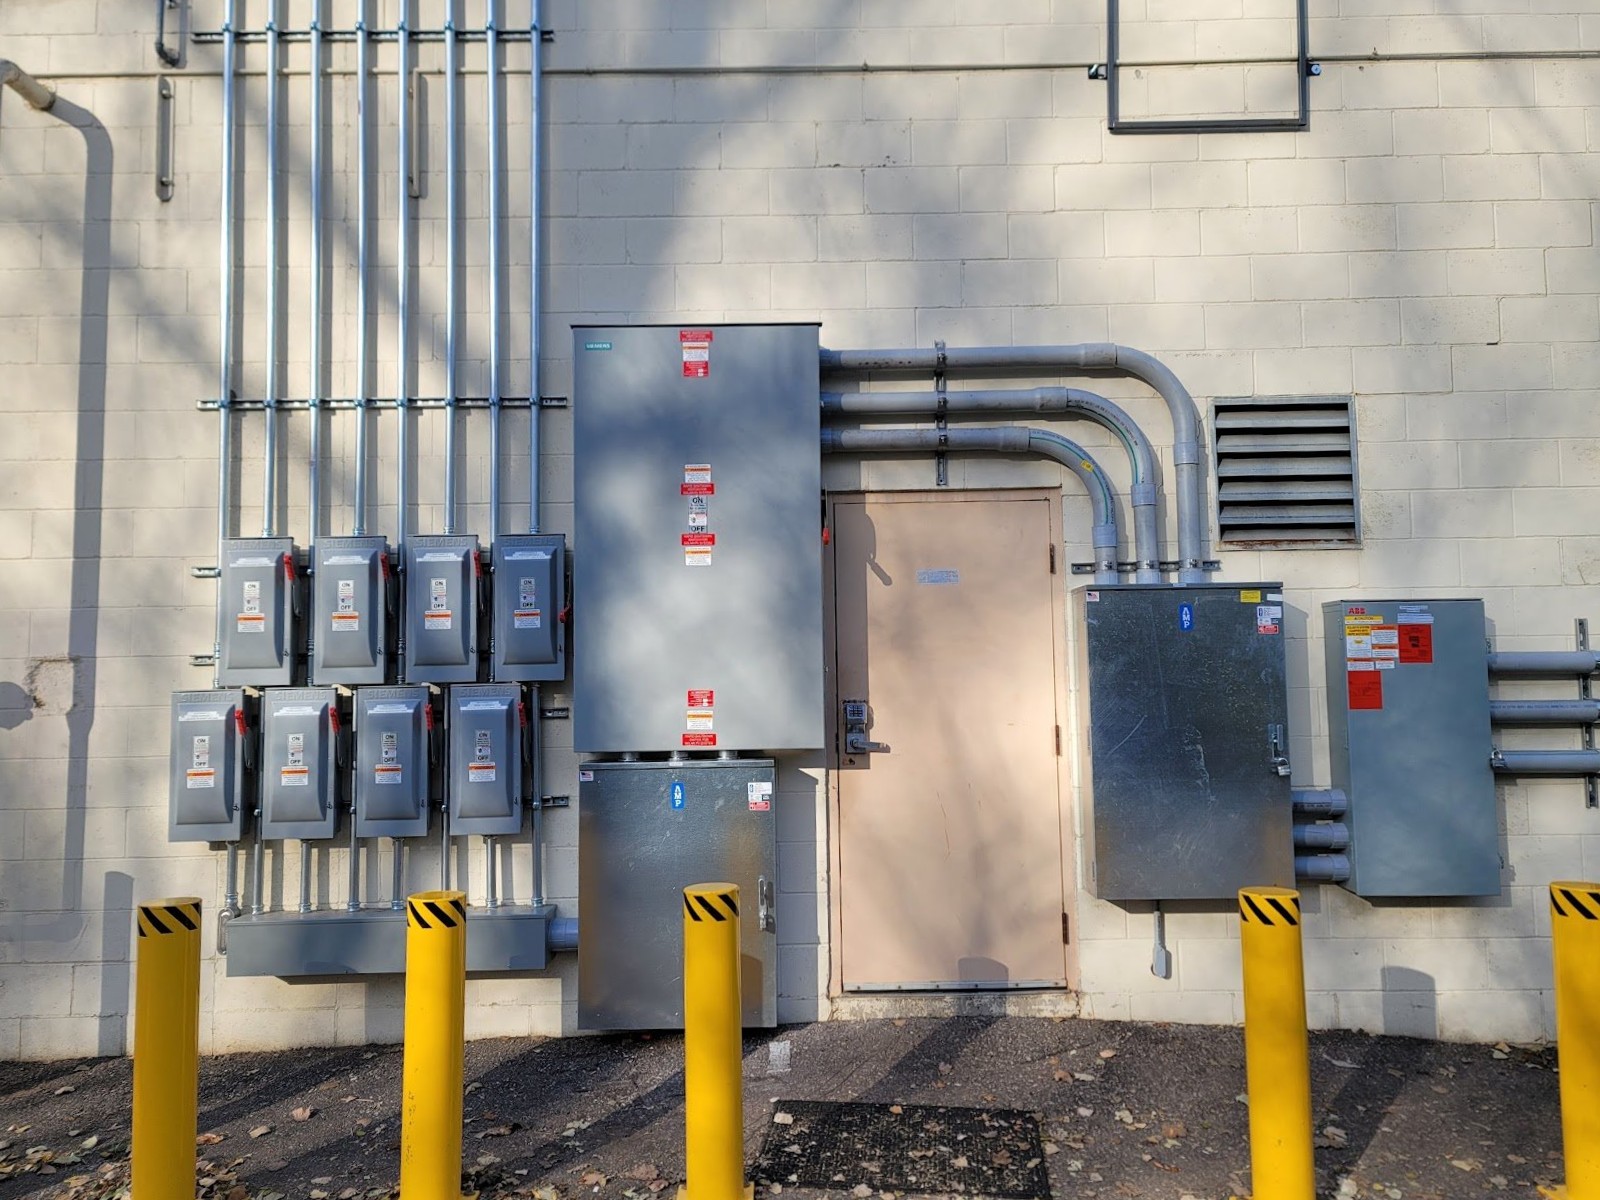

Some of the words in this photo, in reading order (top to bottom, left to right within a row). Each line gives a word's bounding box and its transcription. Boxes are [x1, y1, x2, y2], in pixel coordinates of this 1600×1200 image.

[325, 540, 376, 549] SIEMENS
[416, 538, 468, 547] SIEMENS
[505, 537, 554, 546] SIEMENS
[1182, 607, 1191, 629] AMP
[276, 691, 327, 700] SIEMENS
[367, 689, 419, 698] SIEMENS
[461, 687, 511, 696] SIEMENS
[674, 784, 682, 807] AMP
